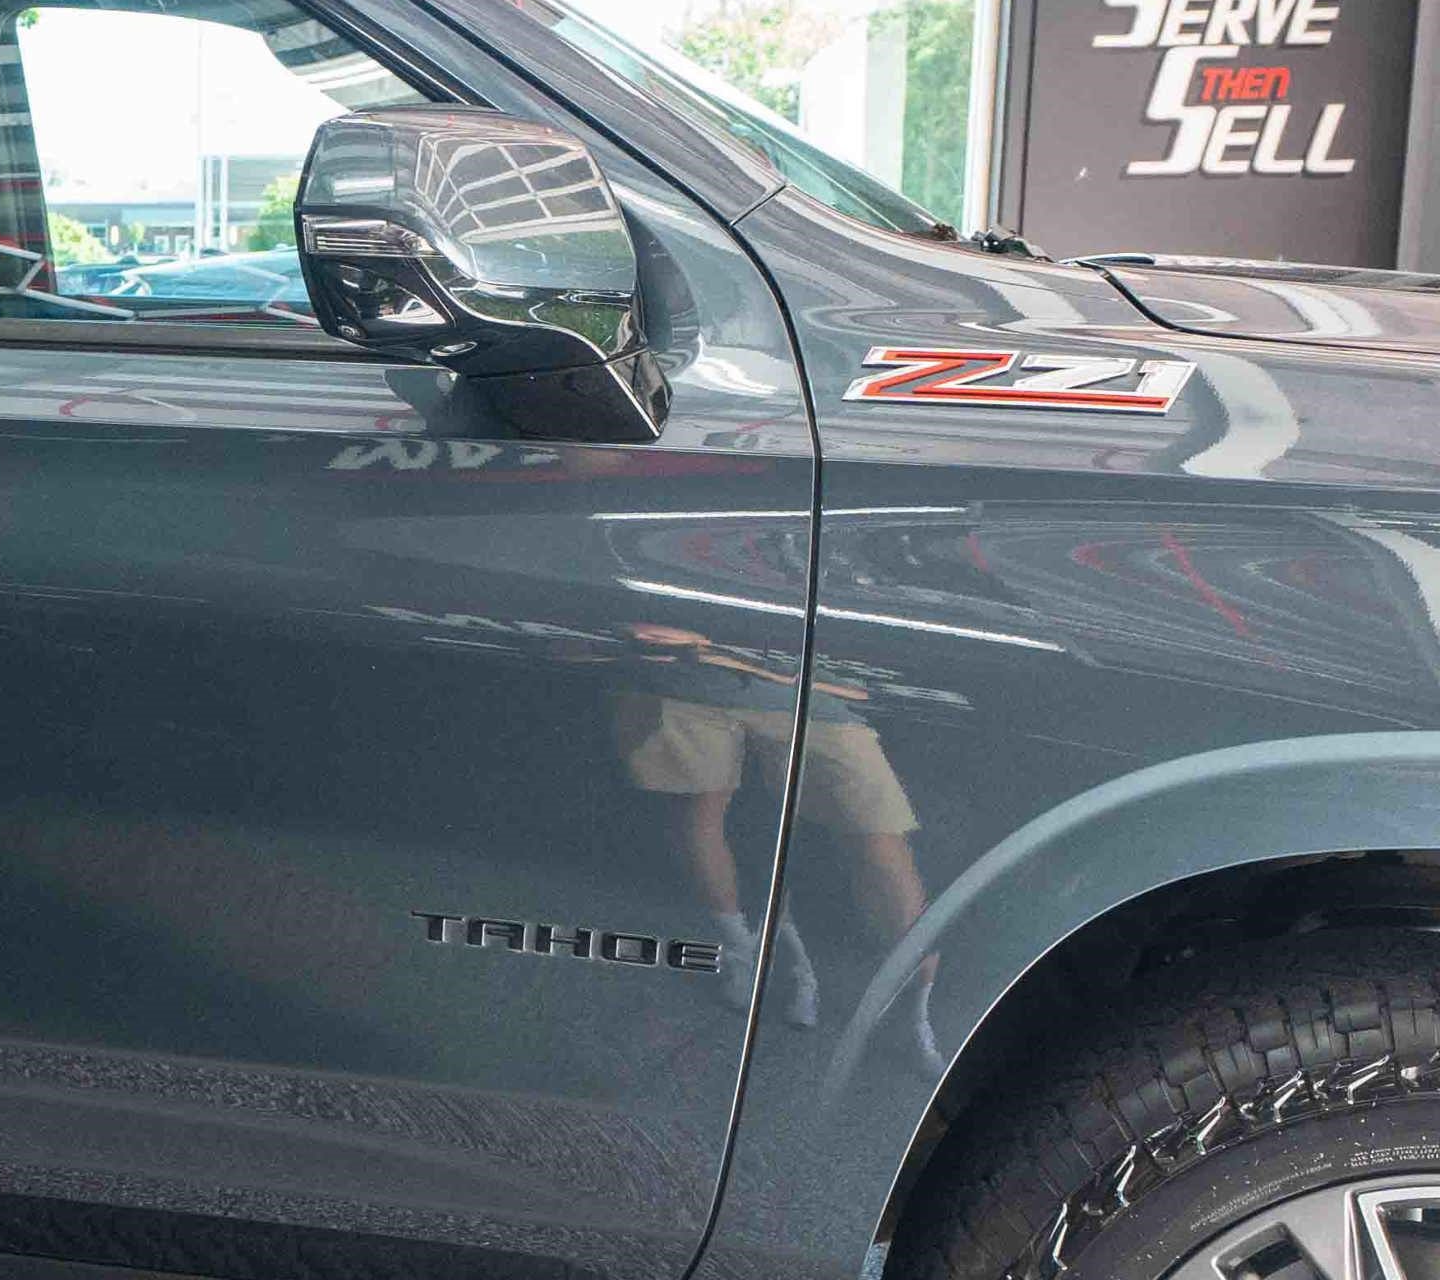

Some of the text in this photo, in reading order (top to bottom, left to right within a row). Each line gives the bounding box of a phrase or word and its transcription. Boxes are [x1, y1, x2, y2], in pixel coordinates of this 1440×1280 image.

[1126, 45, 1355, 175] SELL
[1201, 65, 1290, 102] THEN
[842, 346, 1198, 416] Z71
[411, 910, 722, 974] TAHOE
